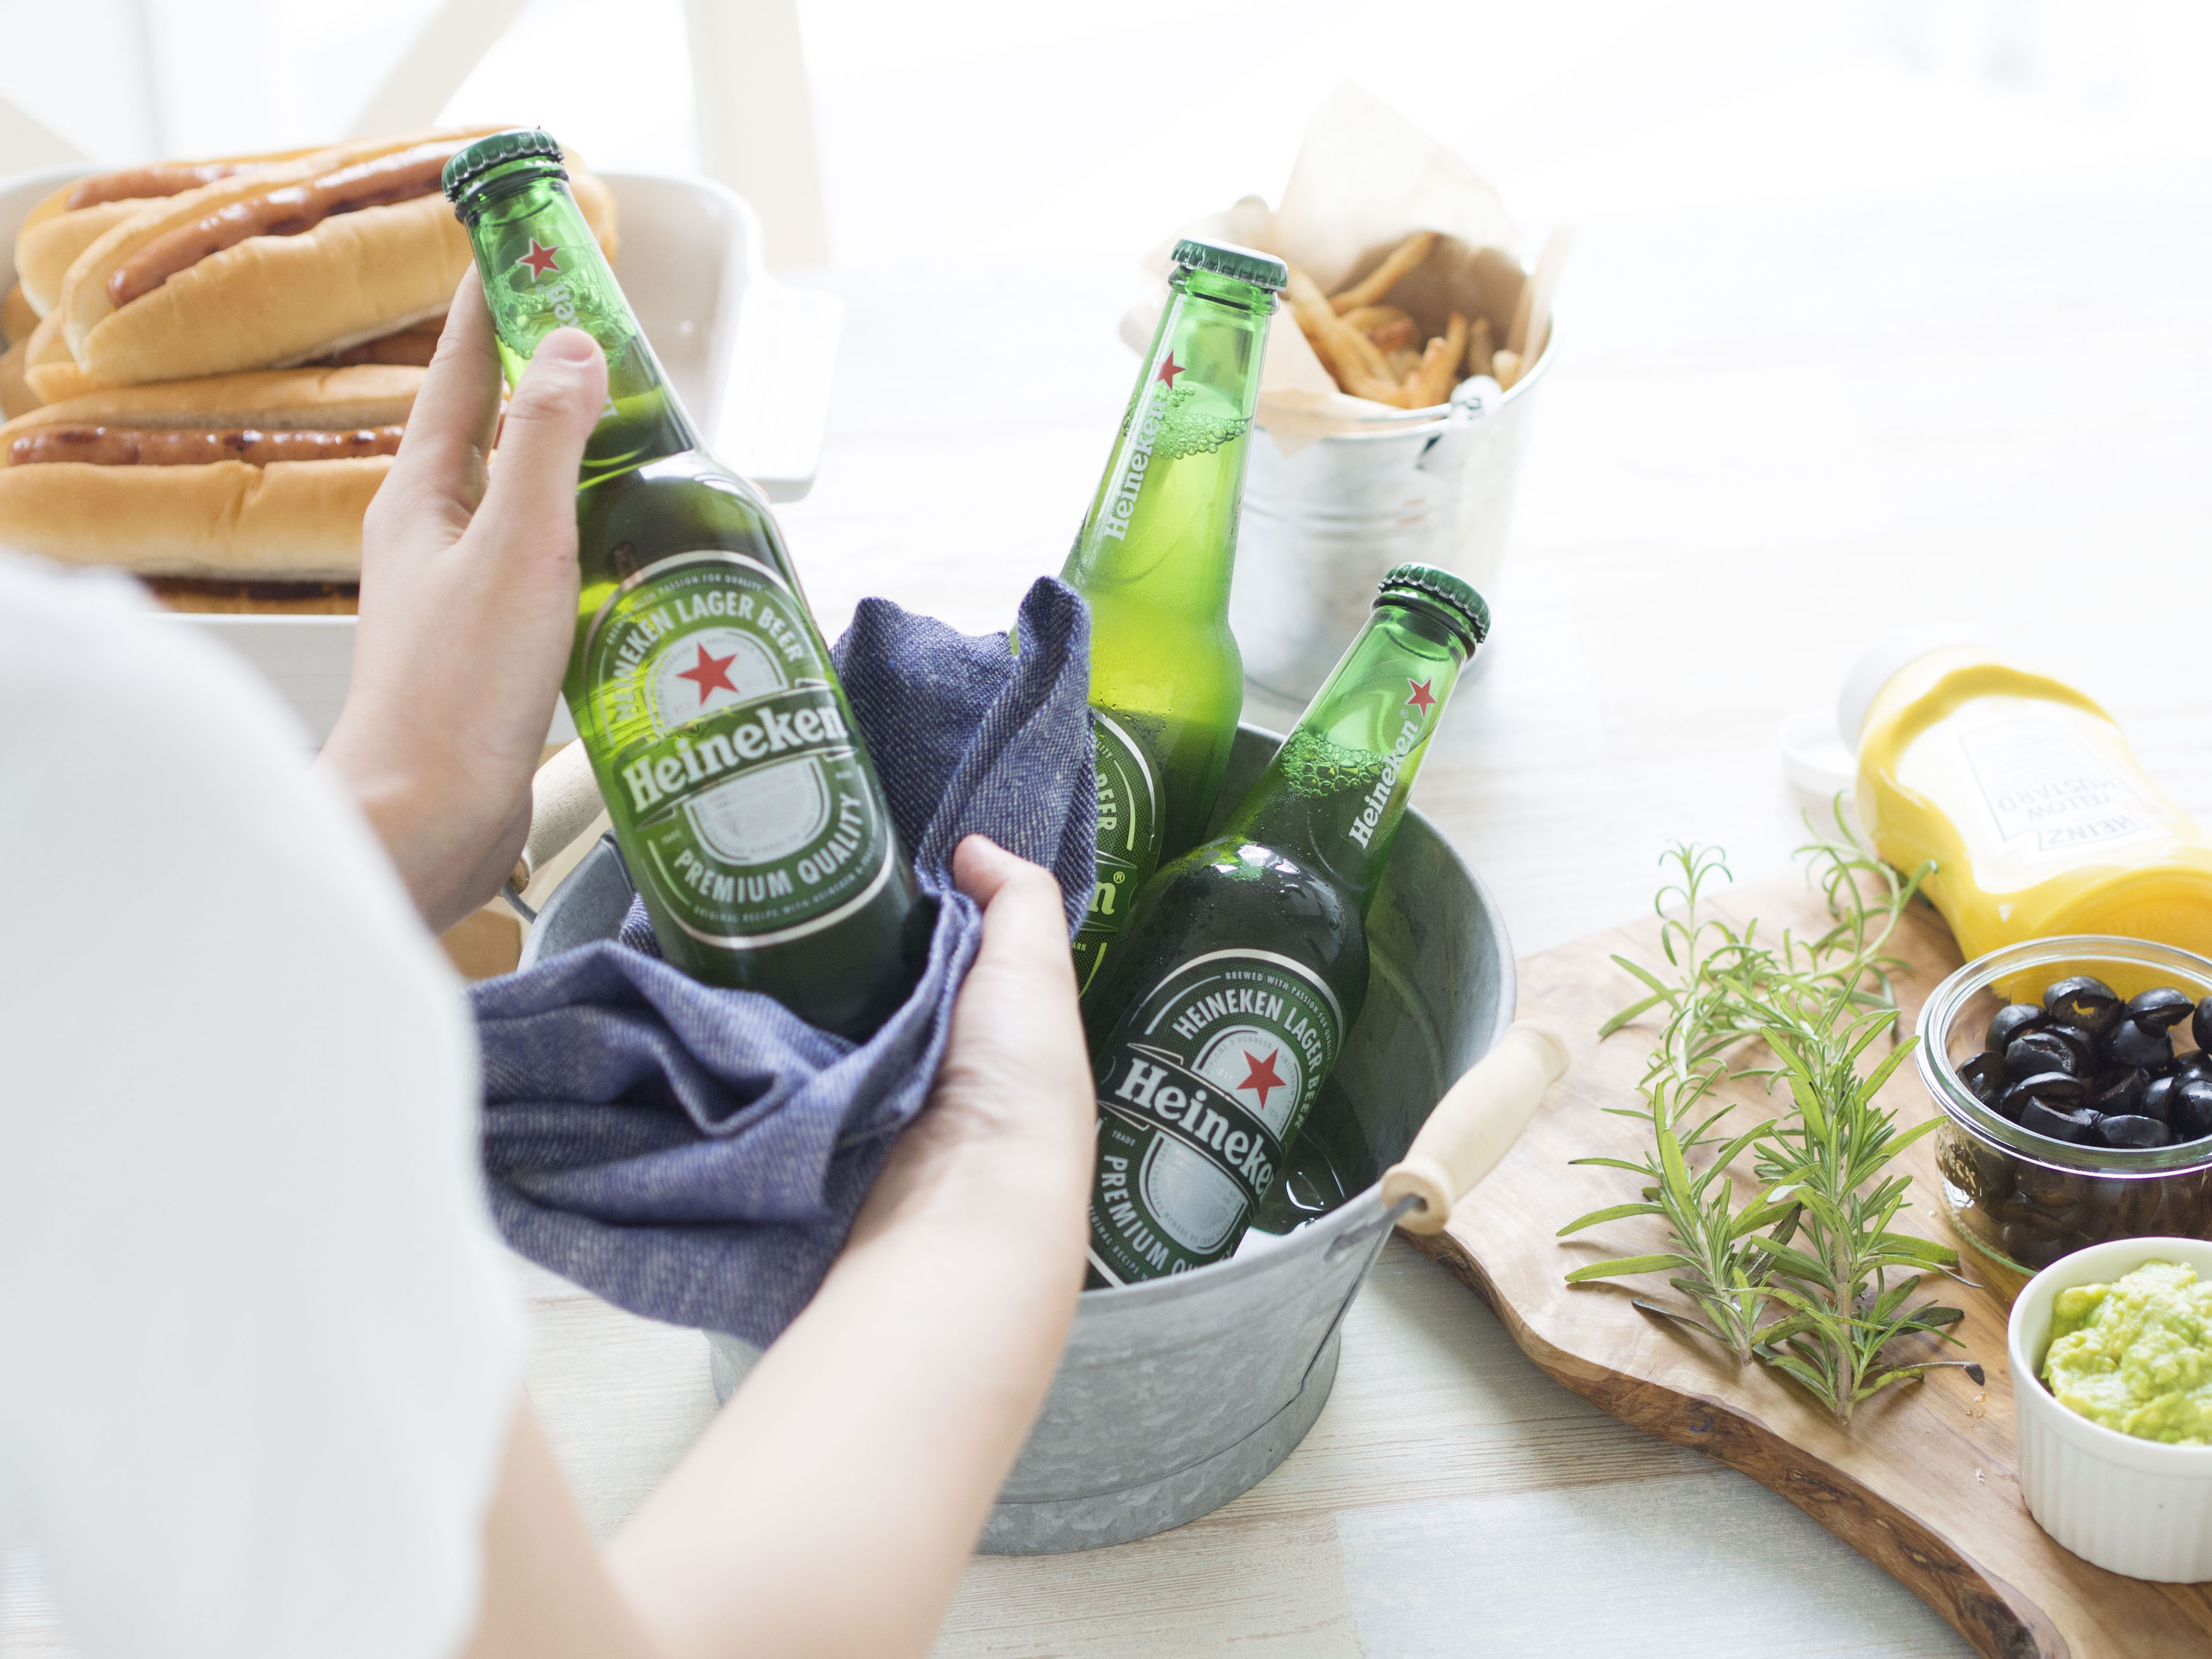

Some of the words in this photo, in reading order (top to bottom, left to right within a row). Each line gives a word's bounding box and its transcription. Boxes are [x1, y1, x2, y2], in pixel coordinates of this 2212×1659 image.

[1105, 399, 1167, 542] Heineken
[702, 573, 721, 582] FOR
[613, 605, 675, 722] HEINEKEN
[674, 590, 755, 623] LAGER
[757, 605, 804, 662] BEER
[622, 704, 848, 813] Heineken
[1096, 739, 1114, 759] LITY
[1349, 720, 1418, 849] Heineken
[1998, 777, 2119, 812] MUSTARD
[2027, 793, 2115, 822] YELLOW
[674, 848, 794, 904] PREMIUM
[798, 793, 863, 885] QUALITY
[2047, 815, 2137, 844] HEINZ
[1172, 988, 1284, 1040] HEINEKEN
[1225, 971, 1263, 981] BREWED
[1267, 975, 1289, 991] WITH
[1291, 985, 1319, 1014] PASSION
[1317, 1012, 1327, 1029] FOR
[1283, 1006, 1323, 1074] LAGER
[1115, 1057, 1274, 1202] Heineke
[1294, 1074, 1320, 1129] BEER
[1112, 1129, 1136, 1147] TRADE
[1089, 1205, 1112, 1245] RIGINAL
[1112, 1245, 1140, 1275] RECIPE
[1101, 1155, 1170, 1272] PREMIUM
